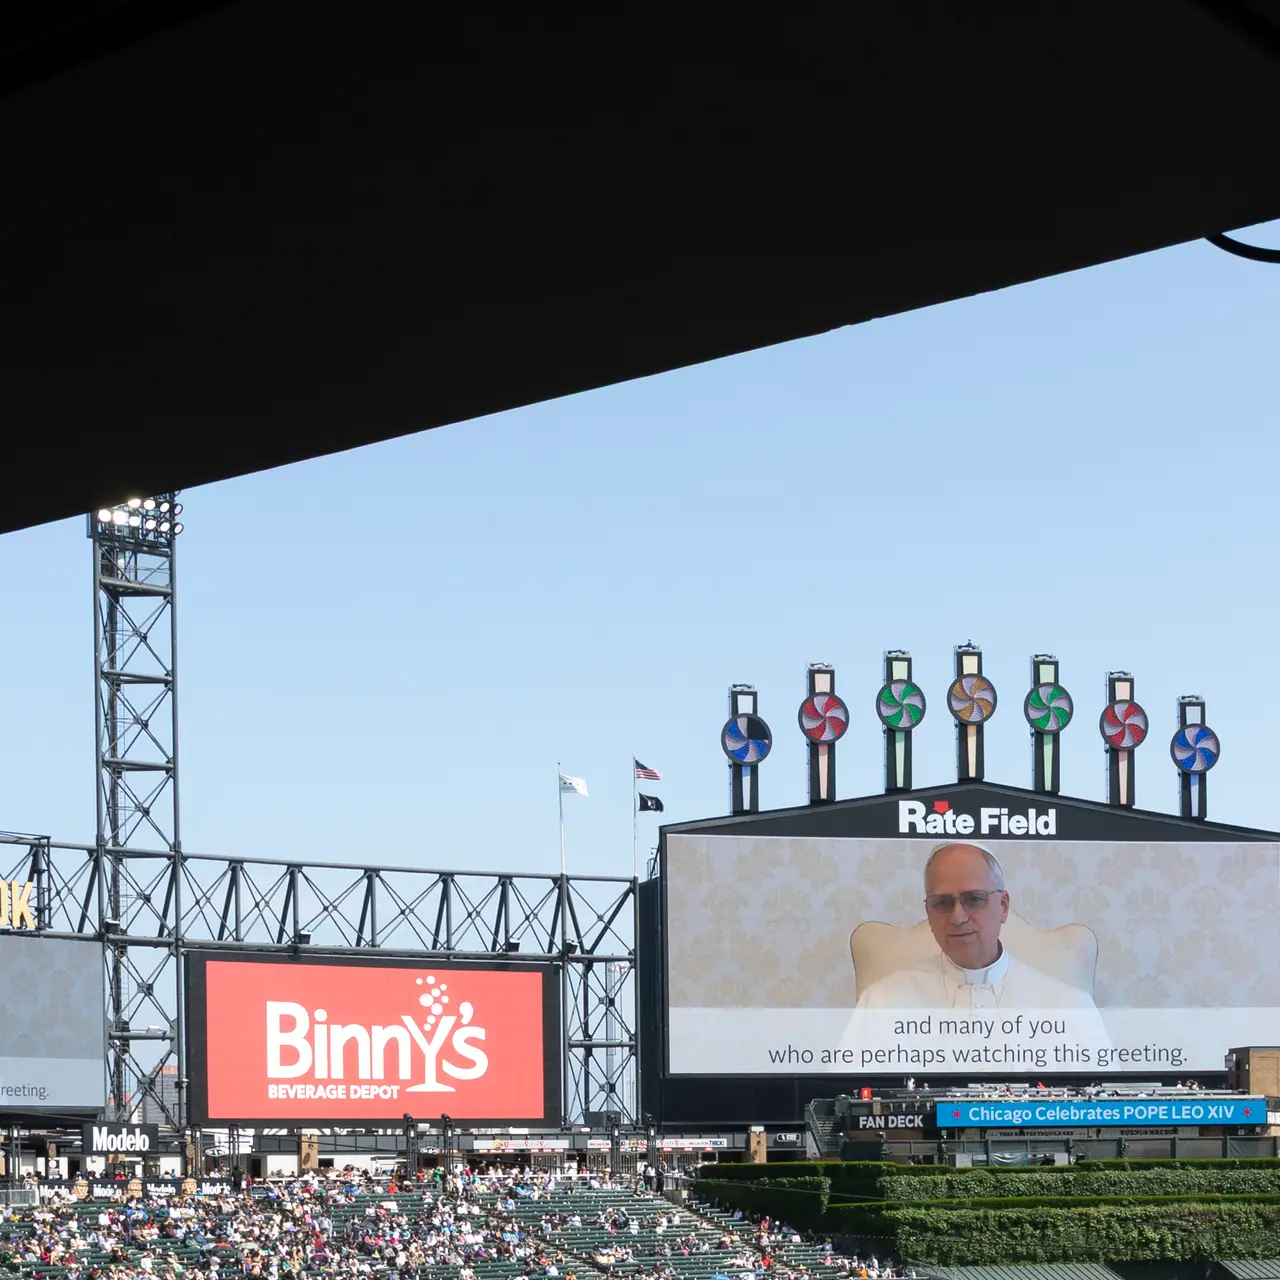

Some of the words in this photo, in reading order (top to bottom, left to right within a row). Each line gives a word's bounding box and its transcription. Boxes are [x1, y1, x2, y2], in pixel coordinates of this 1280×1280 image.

[899, 801, 975, 835] Rate
[981, 806, 1056, 836] Field
[895, 1015, 930, 1035] and
[939, 1020, 995, 1040] many
[1001, 1014, 1023, 1035] of
[1028, 1020, 1065, 1040] you
[266, 1001, 488, 1092] Binny's
[769, 1044, 813, 1064] who
[821, 1049, 854, 1064] are
[861, 1044, 946, 1068] perhaps
[953, 1043, 1047, 1068] watching
[1054, 1043, 1091, 1063] this
[1097, 1043, 1188, 1067] greeting.
[268, 1084, 346, 1099] BEVERAGE
[349, 1084, 400, 1099] DEPOT
[860, 1116, 886, 1128] FAN
[888, 1115, 923, 1128] DECK
[969, 1105, 1032, 1123] Chicago
[1036, 1105, 1120, 1121] Celebrates
[1124, 1106, 1168, 1120] POPE
[1172, 1106, 1204, 1119] LEO
[1208, 1105, 1235, 1119] XIV
[92, 1126, 150, 1152] Modelo
